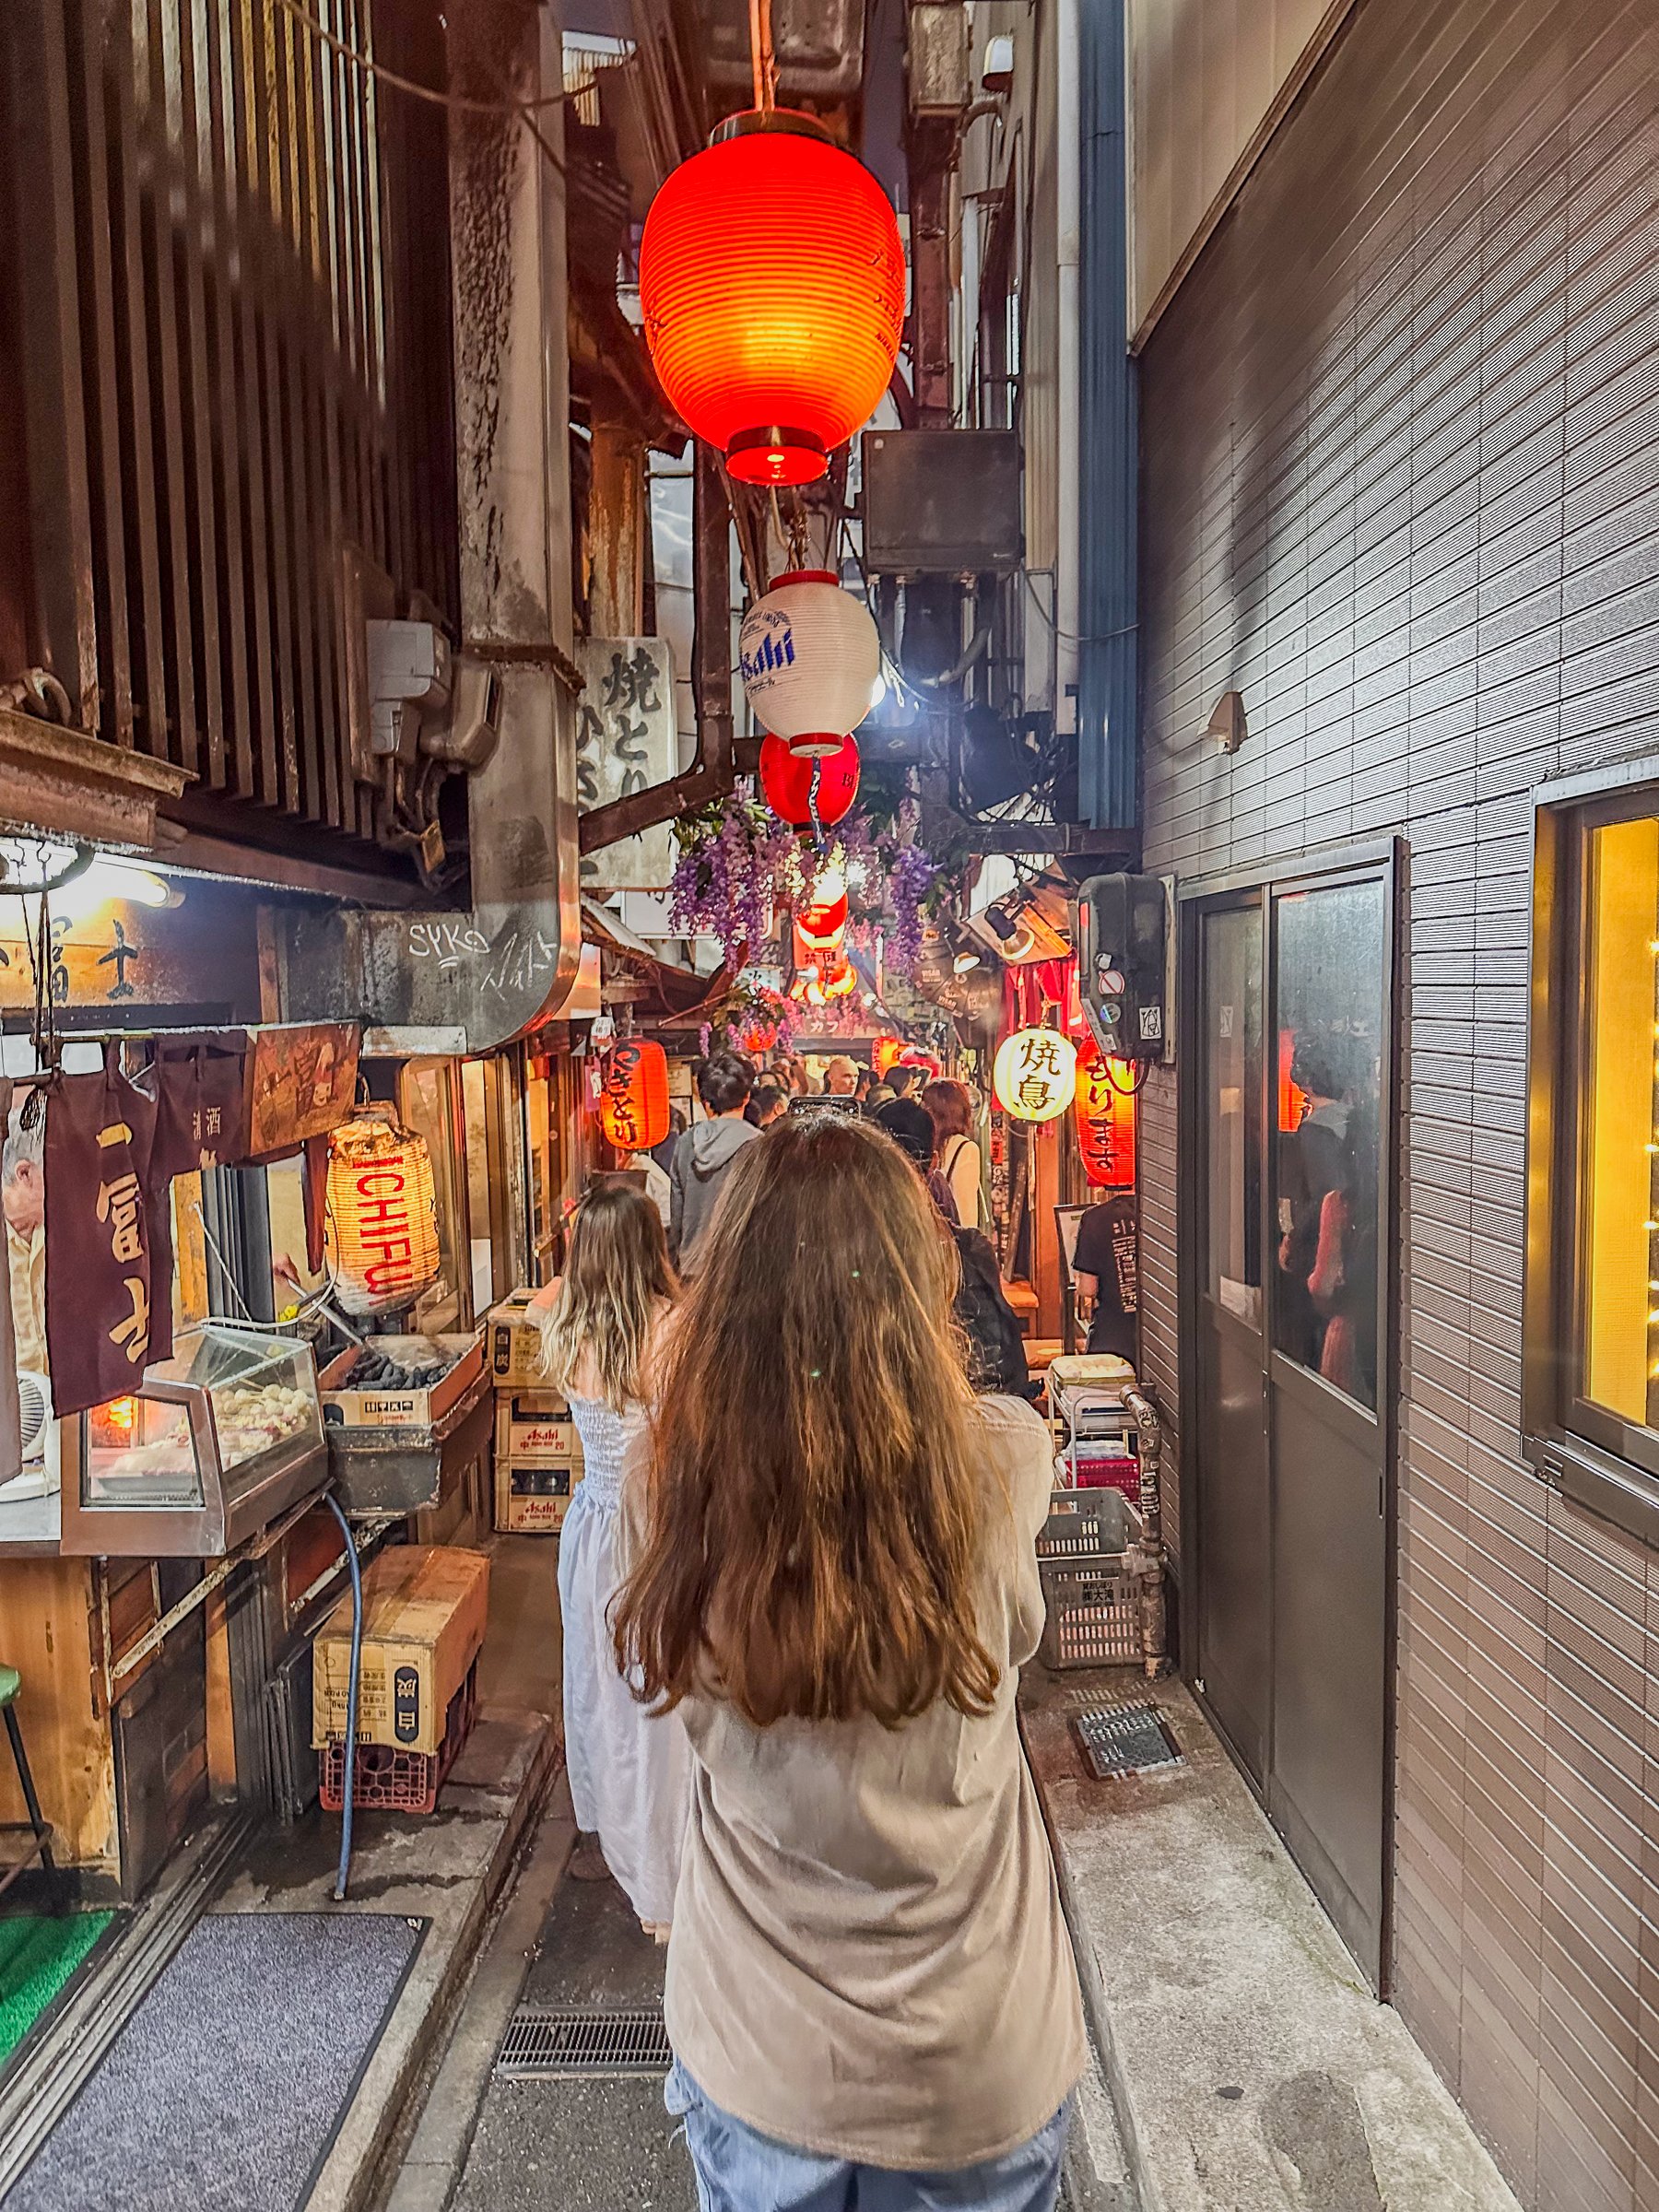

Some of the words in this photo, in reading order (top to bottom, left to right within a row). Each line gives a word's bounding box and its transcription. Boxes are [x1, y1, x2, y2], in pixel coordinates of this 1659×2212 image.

[609, 1043, 641, 1143] やきとり
[1014, 1038, 1061, 1110] 焼鳥
[526, 1429, 559, 1441] Asahi
[524, 1501, 557, 1513] Asahi
[396, 1678, 417, 1731] 白炭
